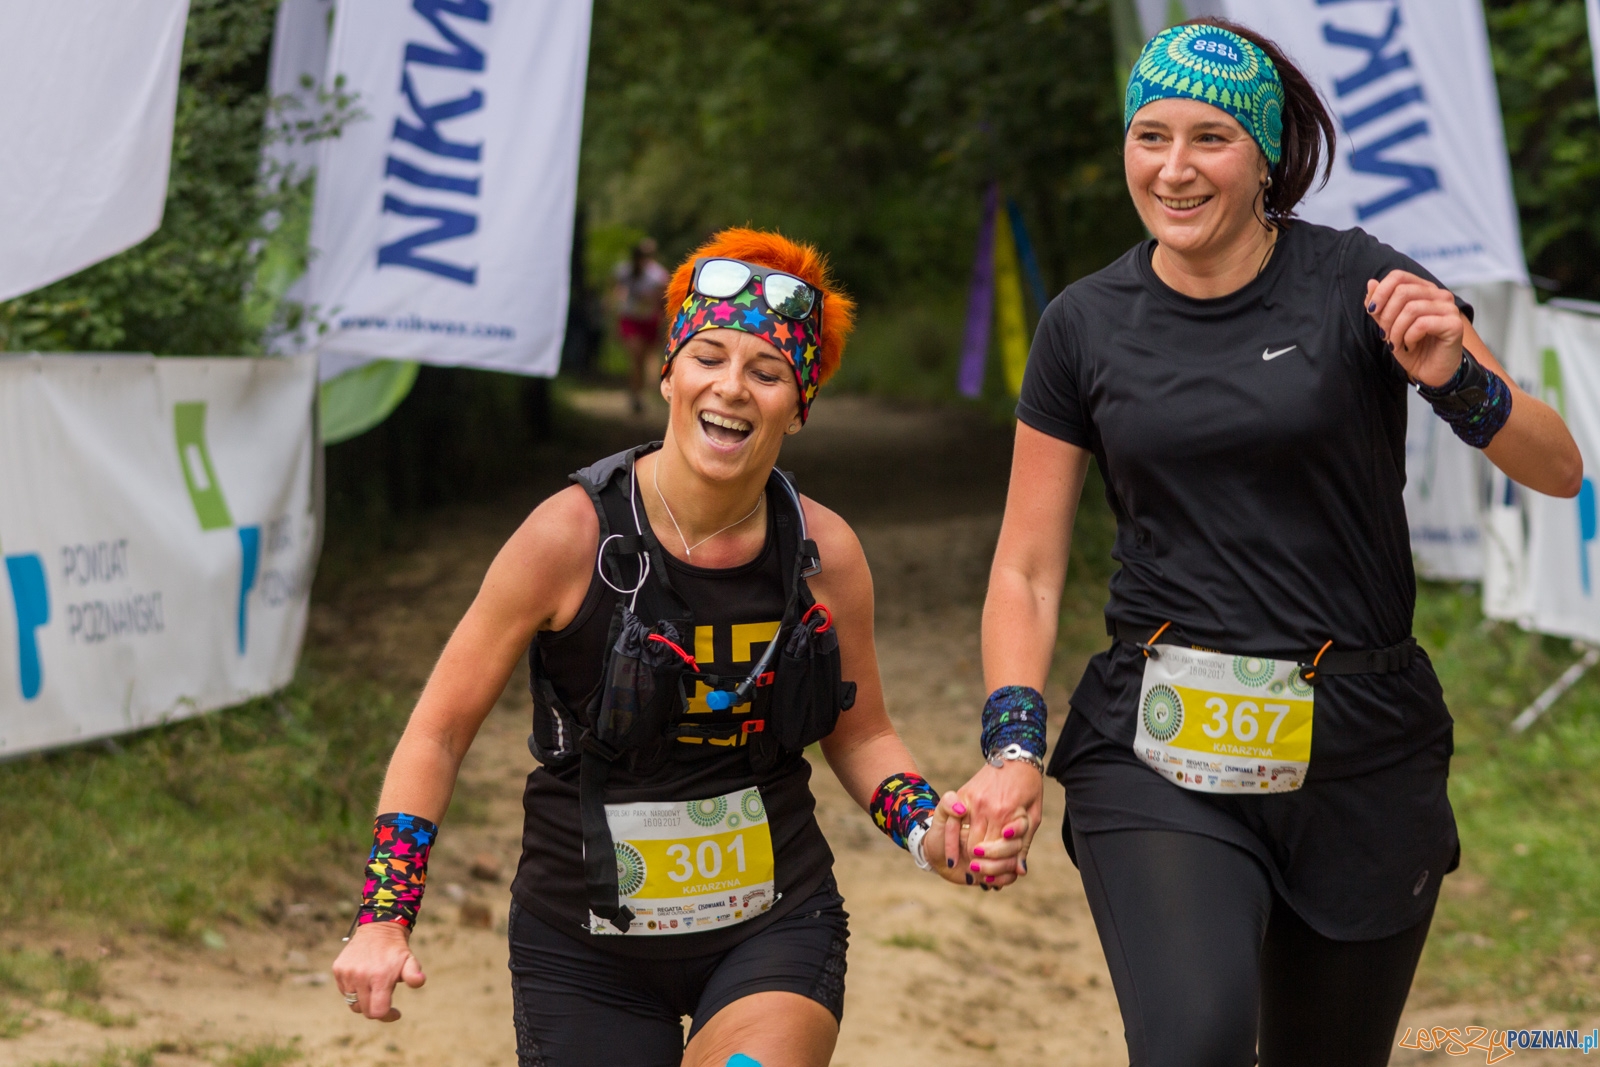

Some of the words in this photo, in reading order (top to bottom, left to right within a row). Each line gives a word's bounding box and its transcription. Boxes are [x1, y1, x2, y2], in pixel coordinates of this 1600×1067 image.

[1202, 697, 1291, 745] 367
[1213, 742, 1273, 757] KATARZYNA
[1186, 759, 1210, 768] REGATTA
[632, 809, 647, 817] PARK
[650, 809, 681, 817] NARODOWY
[666, 834, 746, 883] 301
[682, 878, 741, 894] KATARZYNA
[698, 900, 726, 911] CISOWIANKA
